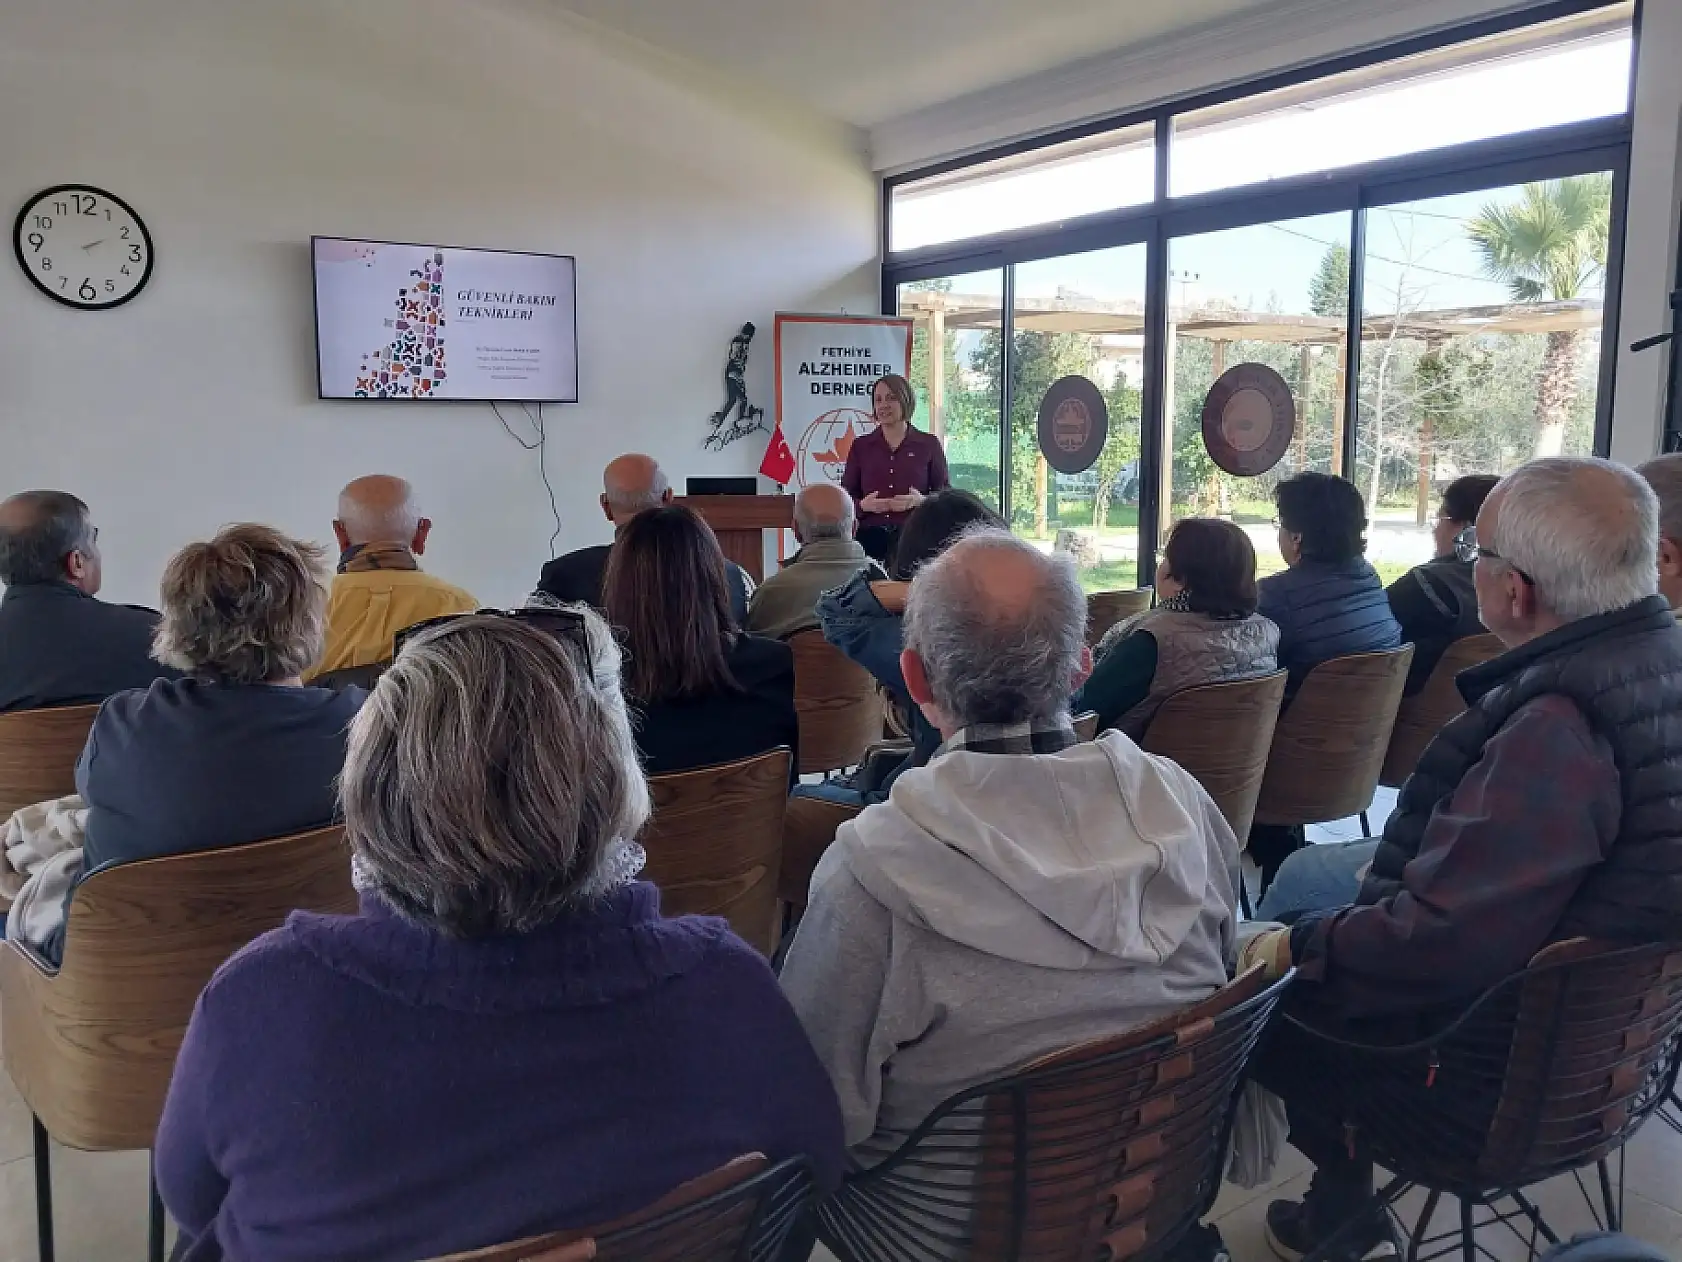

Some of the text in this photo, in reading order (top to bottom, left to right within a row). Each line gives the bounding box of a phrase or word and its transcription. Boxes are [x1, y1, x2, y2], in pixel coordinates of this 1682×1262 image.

[53, 201, 67, 216] 11
[70, 194, 97, 216] 12
[104, 208, 111, 222] 1
[33, 215, 52, 230] 10
[120, 226, 130, 240] 2
[27, 232, 44, 253] 9
[128, 244, 142, 263] 3
[41, 257, 52, 271] 8
[120, 264, 130, 276] 4
[59, 275, 68, 289] 7
[78, 277, 97, 301] 6
[104, 279, 115, 292] 5
[821, 346, 872, 358] FETHİYE
[798, 362, 892, 376] ALZHEIMER
